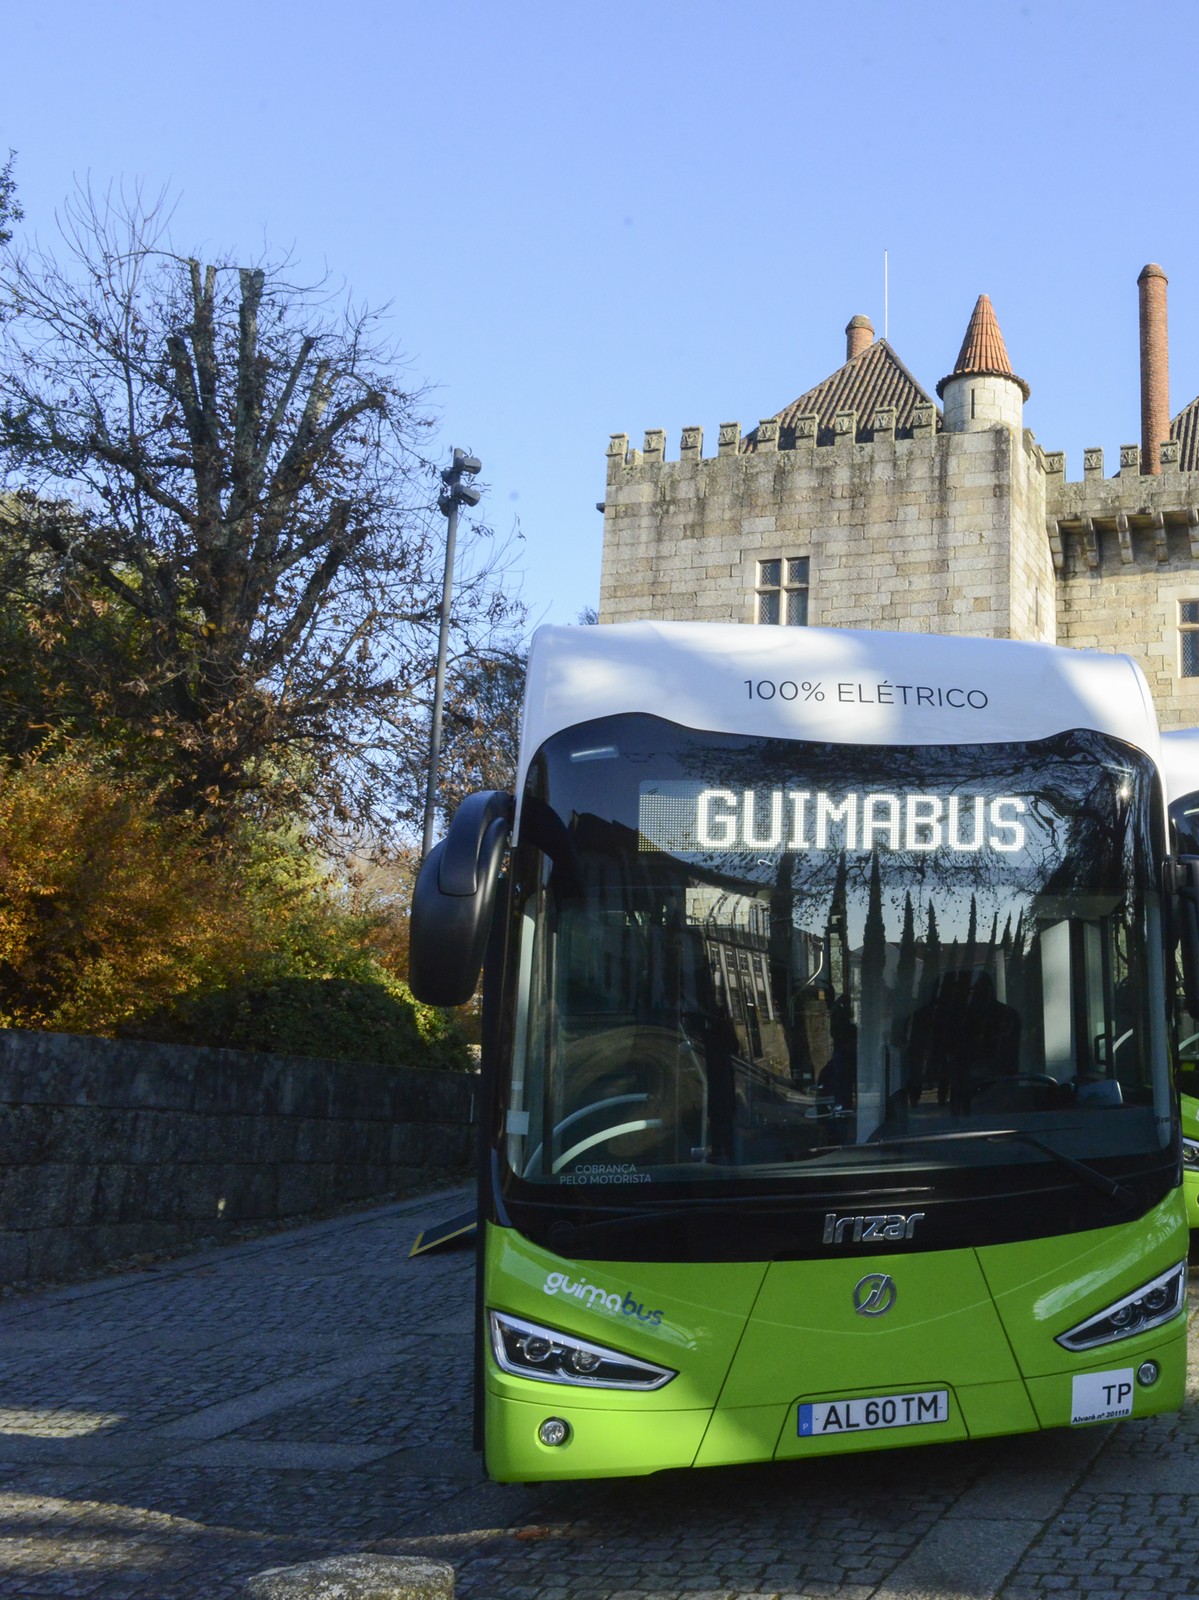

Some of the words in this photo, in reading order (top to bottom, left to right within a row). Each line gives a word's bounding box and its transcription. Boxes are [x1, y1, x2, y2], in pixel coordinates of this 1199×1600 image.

[744, 680, 825, 701] 100%
[837, 680, 989, 709] ELÉTRICO
[697, 789, 1026, 852] GUIMABUS
[560, 1175, 587, 1185] PELO
[590, 1173, 652, 1184] MOTORISTA
[575, 1163, 637, 1175] COBRANÇA
[543, 1271, 665, 1326] guimabus
[1102, 1383, 1132, 1406] TP
[1072, 1413, 1096, 1423] Alvará
